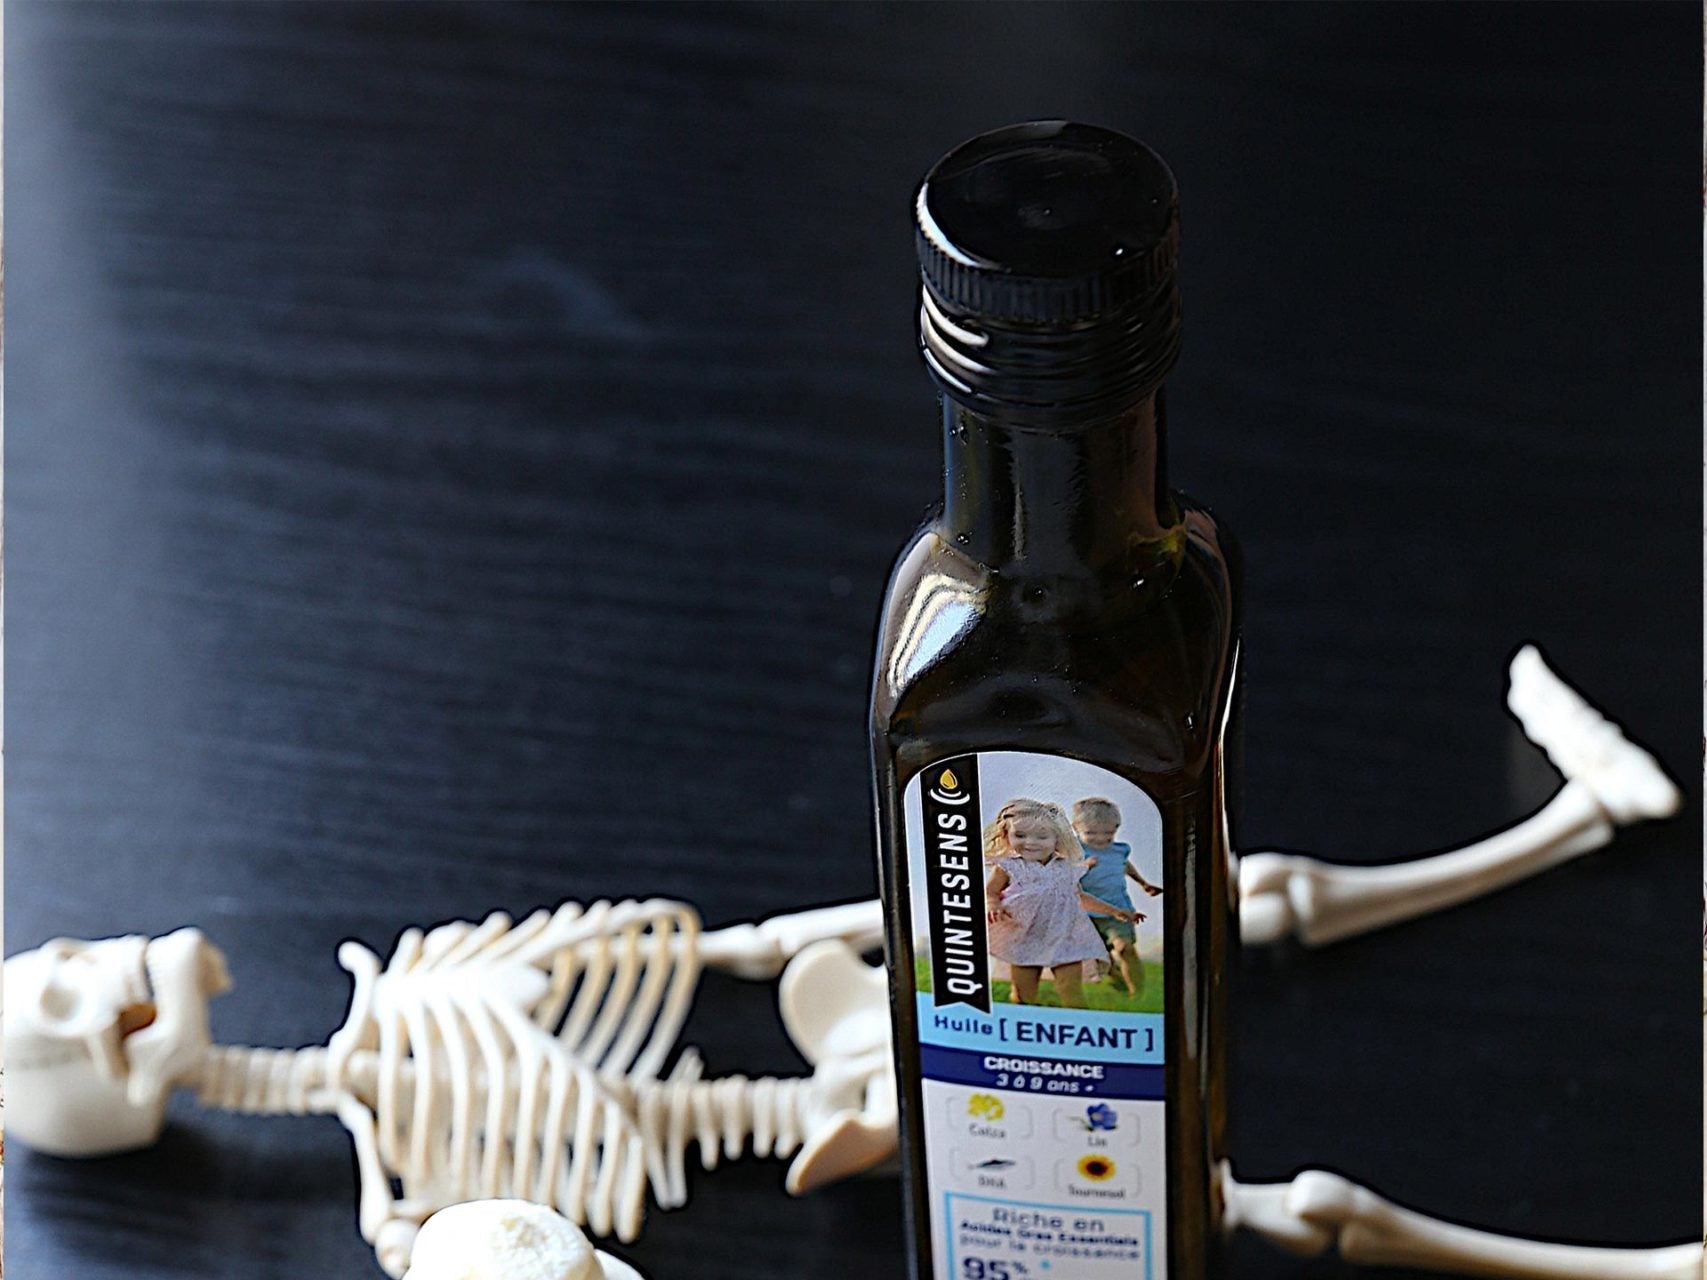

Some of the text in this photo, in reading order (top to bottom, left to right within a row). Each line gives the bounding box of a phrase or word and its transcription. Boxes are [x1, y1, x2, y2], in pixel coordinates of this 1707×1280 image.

[937, 812, 983, 995] QUINTESENS
[935, 1014, 993, 1035] Huile
[983, 1055, 1104, 1079] CROISSANCE
[996, 1074, 1008, 1087] 3
[1029, 1076, 1042, 1090] 9
[1047, 1081, 1079, 1093] ans
